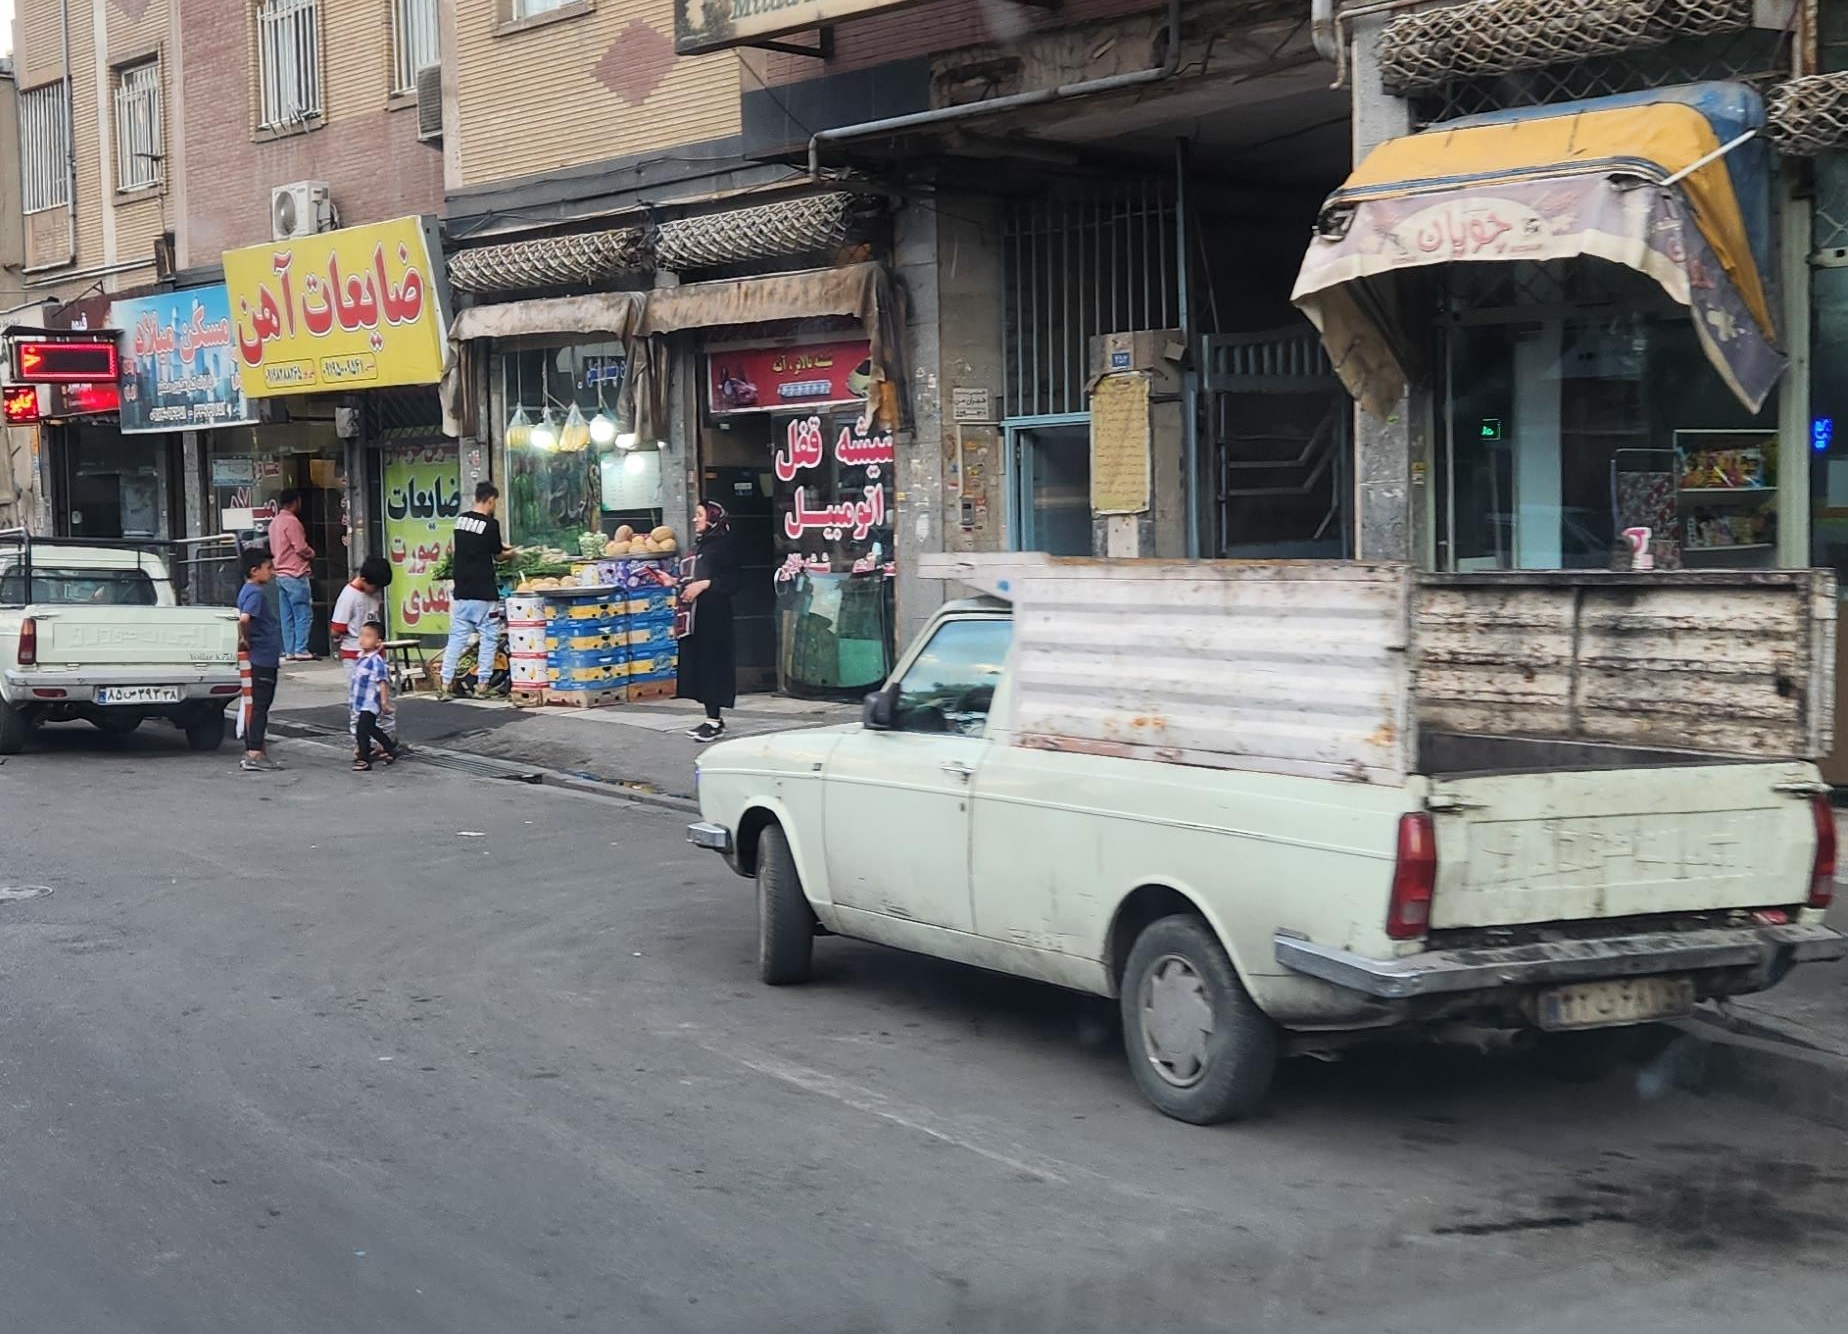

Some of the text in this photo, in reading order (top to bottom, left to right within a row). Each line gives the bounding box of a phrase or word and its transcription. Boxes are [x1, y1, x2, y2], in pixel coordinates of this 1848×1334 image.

[238, 241, 424, 367] ضایعات آهن
[135, 305, 230, 363] مسکن میلاد
[775, 416, 822, 481] قفل
[386, 475, 461, 530] ضایعات
[784, 483, 884, 541] اتومبیل
